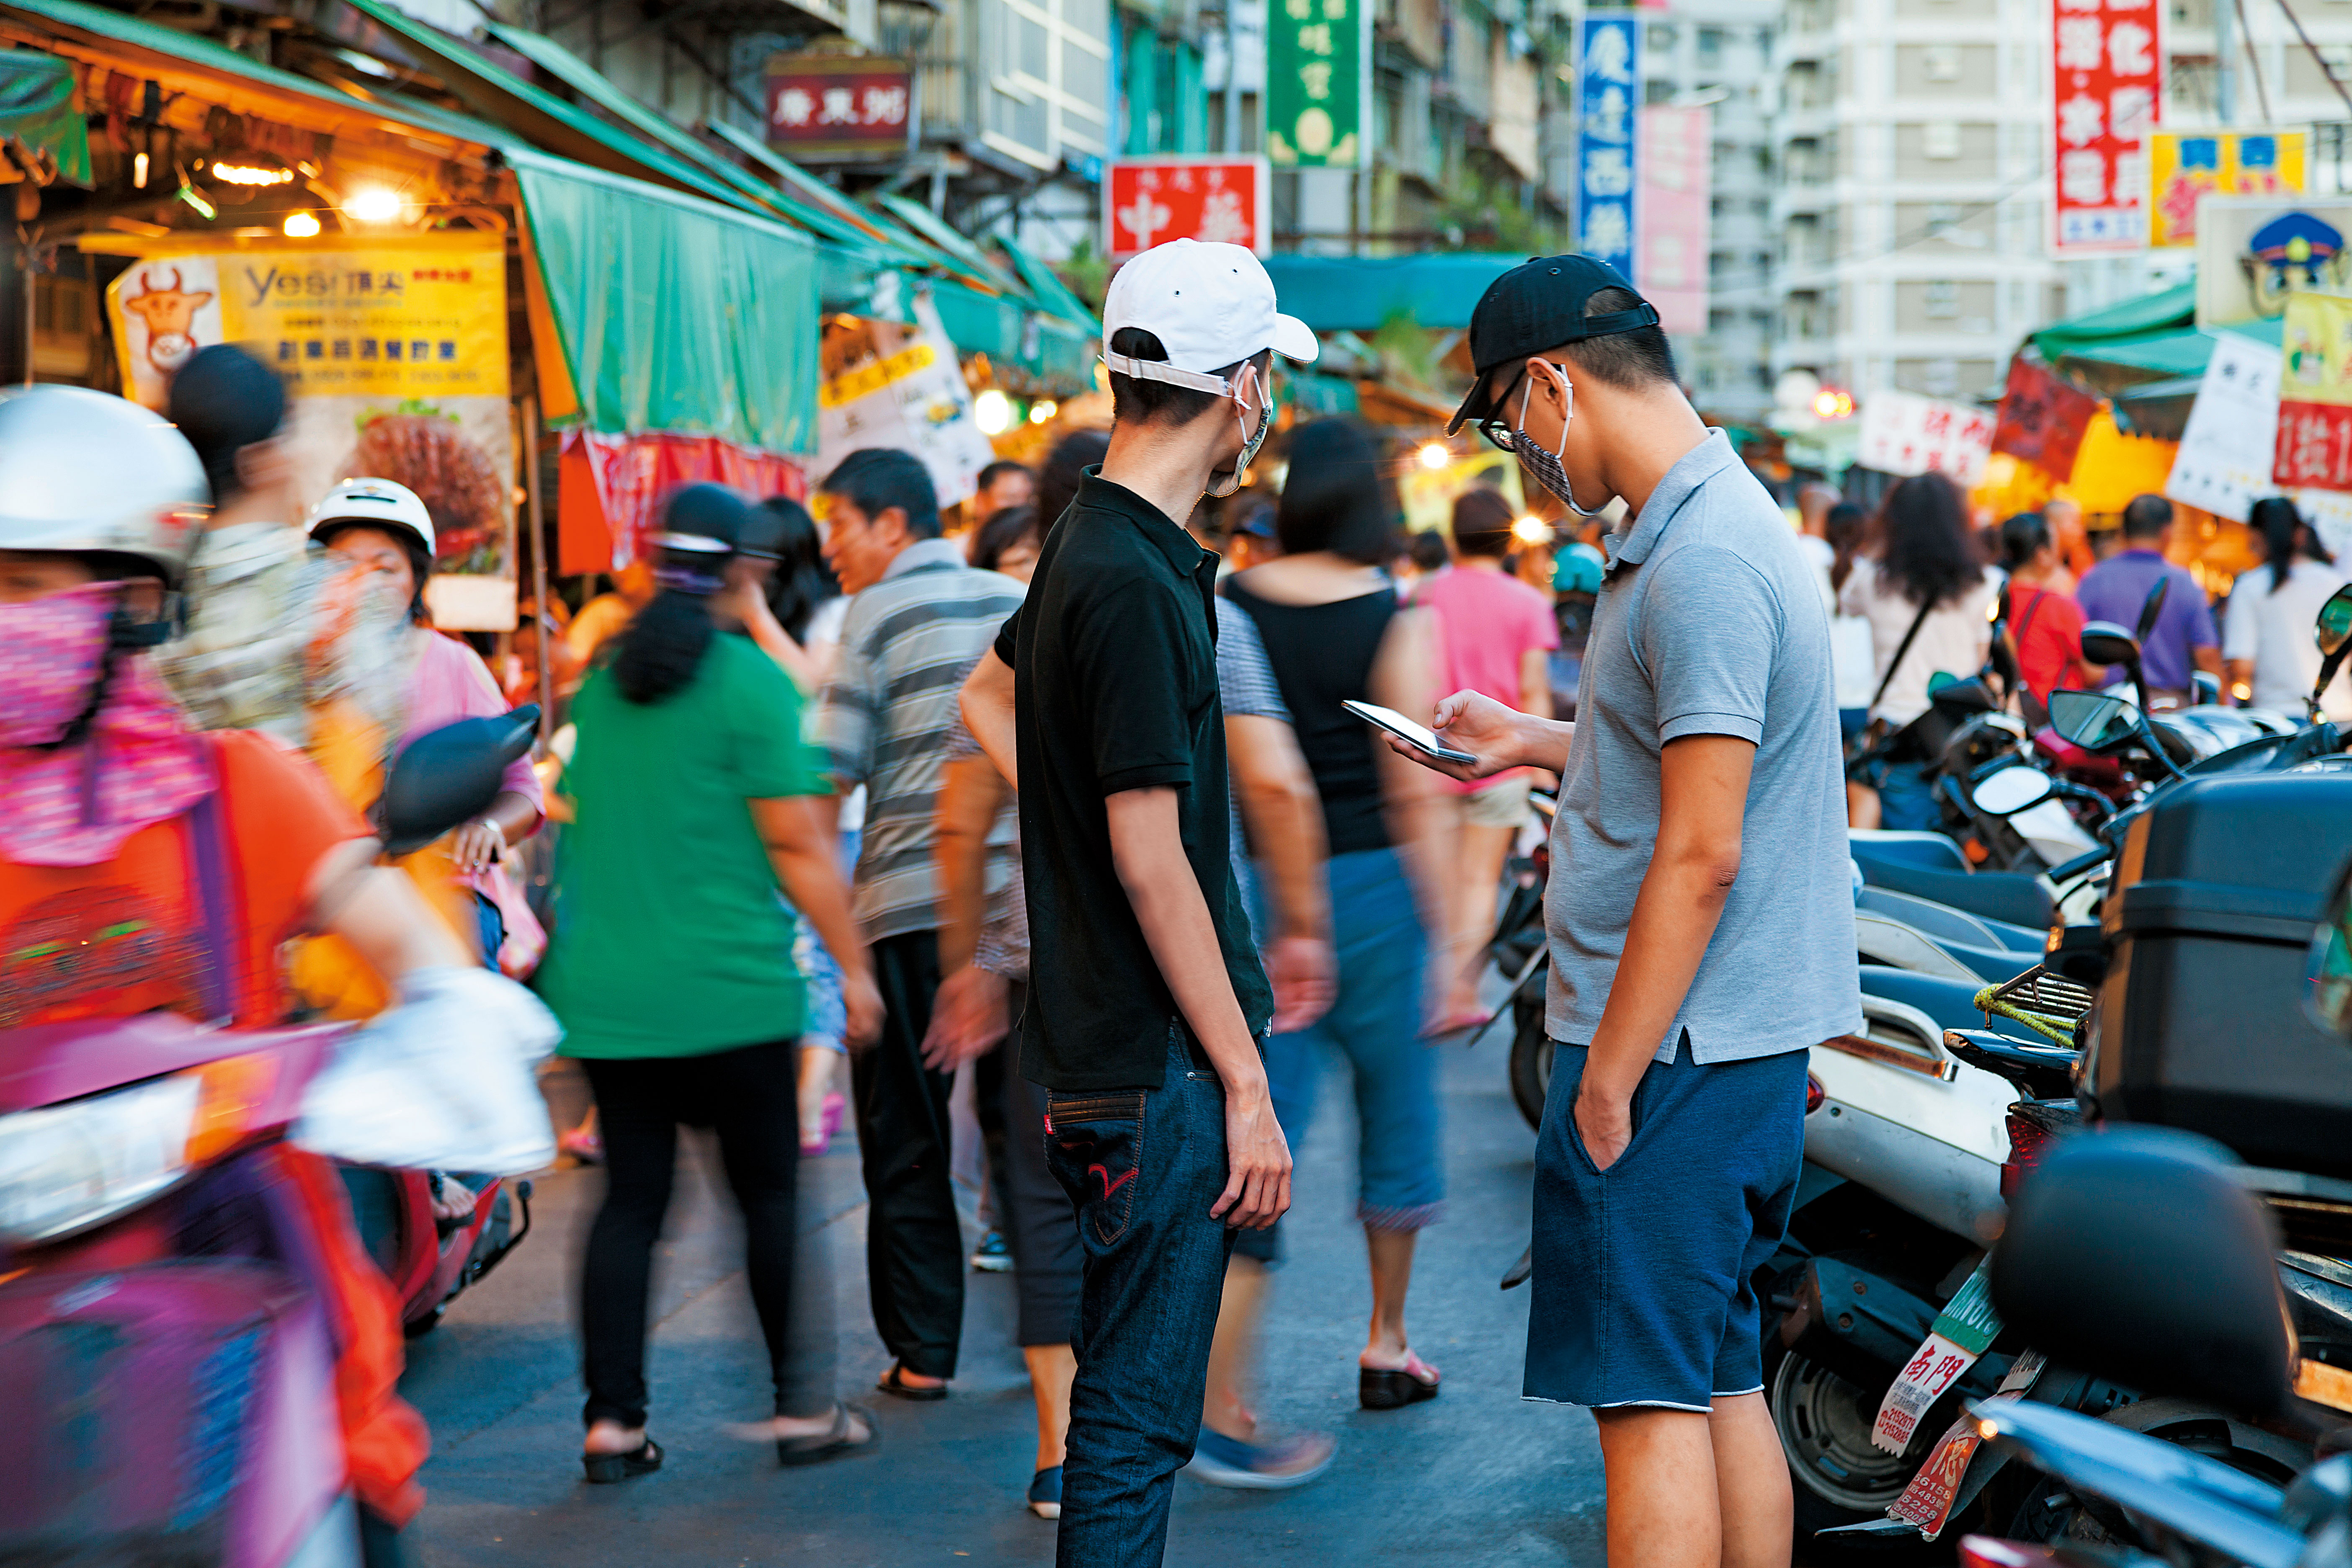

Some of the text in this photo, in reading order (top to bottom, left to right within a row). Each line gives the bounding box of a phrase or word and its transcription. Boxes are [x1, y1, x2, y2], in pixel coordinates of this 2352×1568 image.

[773, 85, 907, 127] 廣東粥
[1904, 1344, 1965, 1396] 南門
